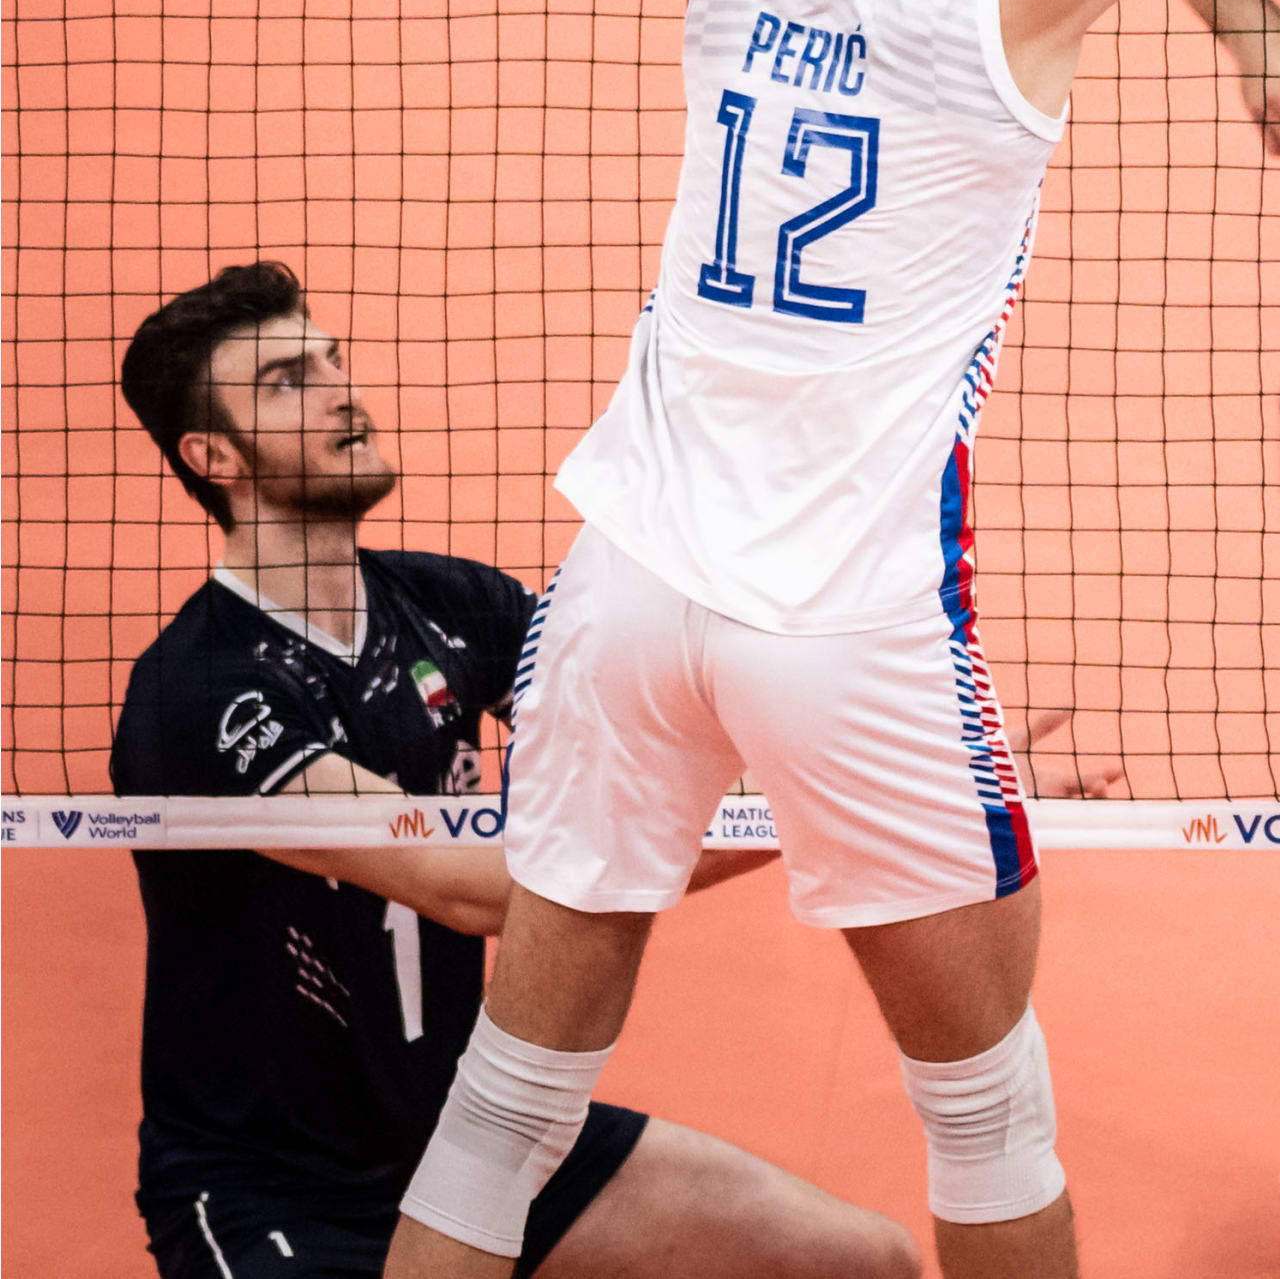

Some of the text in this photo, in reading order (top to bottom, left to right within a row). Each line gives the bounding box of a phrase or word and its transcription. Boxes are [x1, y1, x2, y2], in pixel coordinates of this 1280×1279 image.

[742, 11, 867, 97] PERIĆ
[697, 88, 881, 324] 12
[88, 812, 161, 827] Volleyball
[389, 807, 435, 839] VNL
[722, 808, 773, 821] NATIO
[88, 826, 137, 839] World
[722, 825, 778, 838] LEAGU
[1182, 814, 1228, 844] VNL
